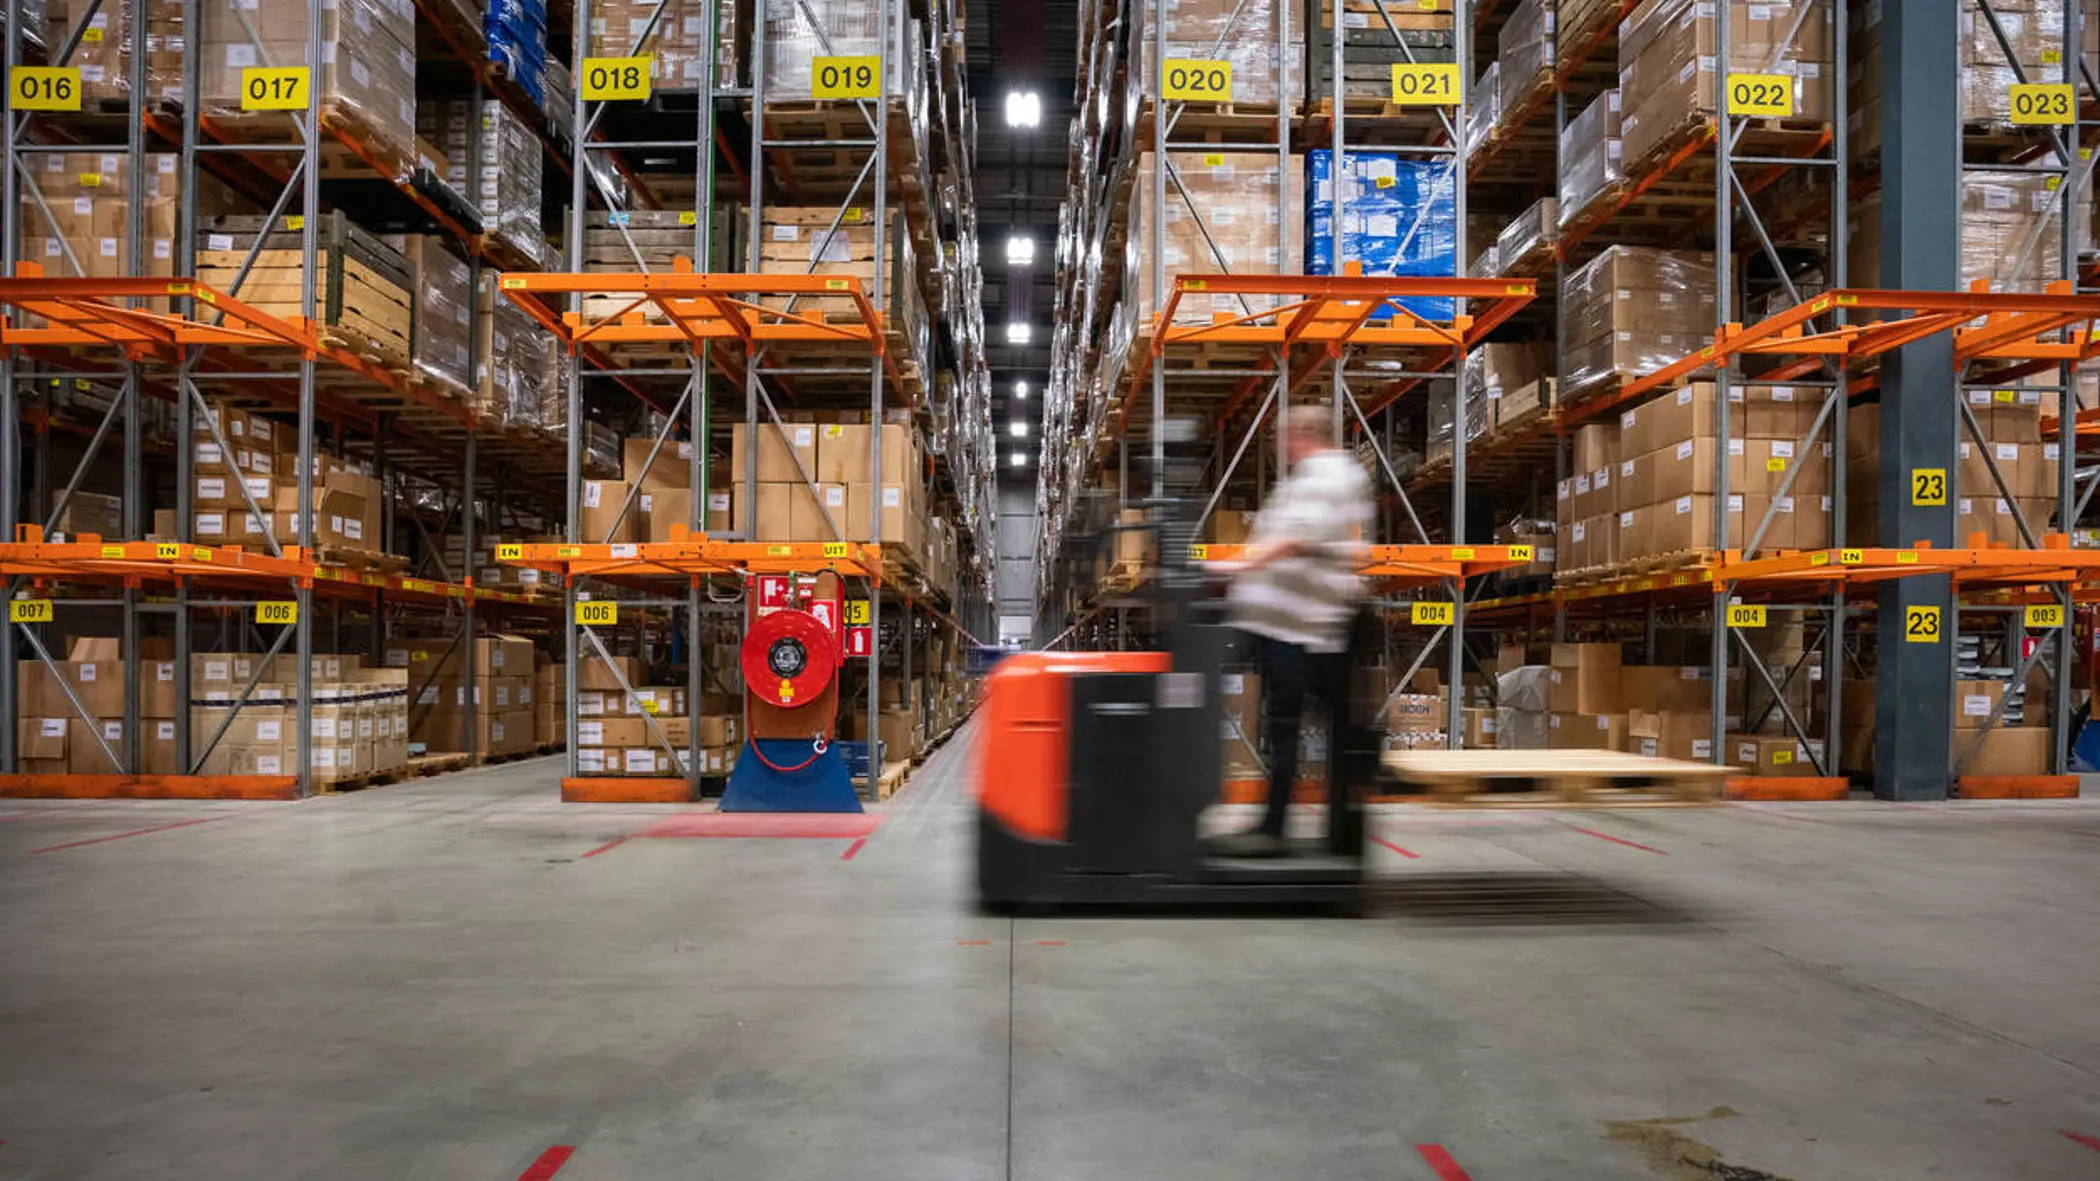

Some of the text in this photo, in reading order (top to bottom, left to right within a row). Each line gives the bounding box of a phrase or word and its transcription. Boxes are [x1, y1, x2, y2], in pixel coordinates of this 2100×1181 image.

[590, 66, 640, 91] 018
[820, 65, 872, 89] 019
[1169, 68, 1226, 92] 020
[1400, 72, 1450, 95] 021
[20, 76, 71, 101] 016
[249, 77, 299, 101] 017
[1734, 83, 1785, 107] 022
[2016, 92, 2069, 115] 023
[1915, 473, 1944, 501] 23
[159, 547, 176, 556] IN
[501, 548, 519, 557] IN
[825, 546, 844, 555] UIT
[1511, 549, 1528, 557] IN
[1843, 552, 1860, 561] IN
[18, 603, 45, 618] 007
[264, 604, 290, 620] 006
[583, 605, 609, 621] 006
[1420, 605, 1446, 621] 004
[1734, 608, 1758, 623] 004
[2032, 608, 2057, 623] 003
[1908, 611, 1938, 637] 23
